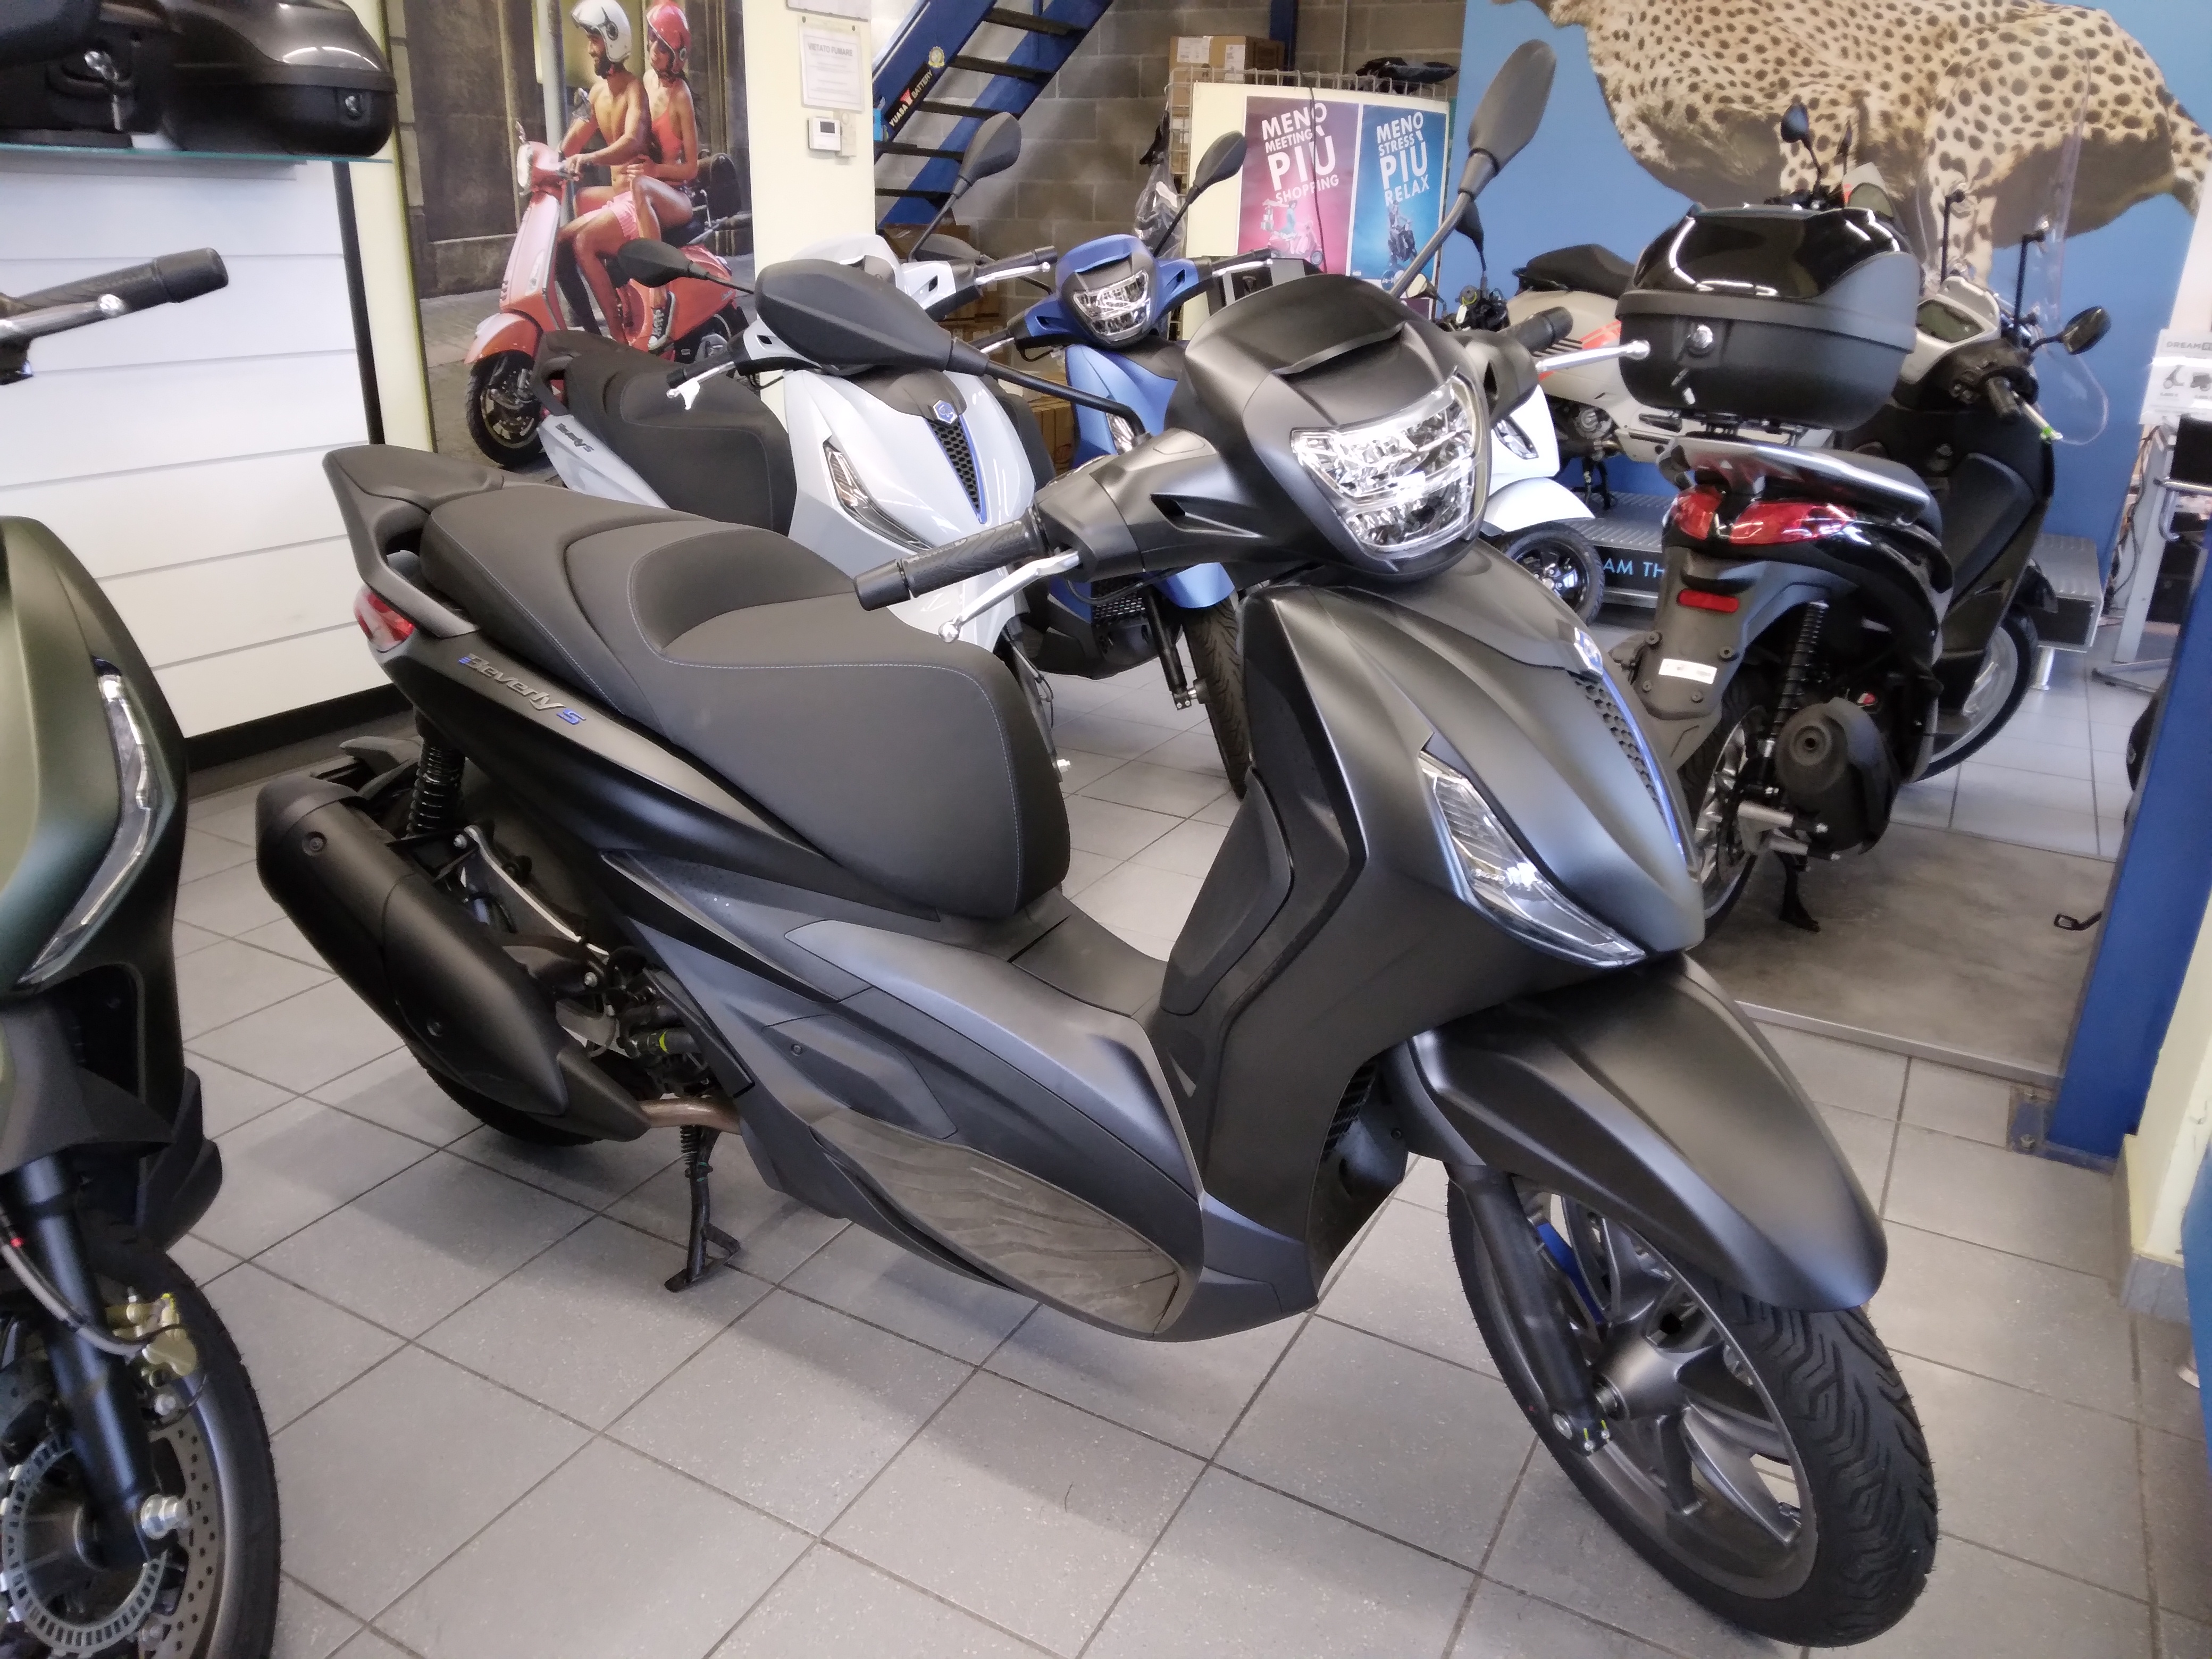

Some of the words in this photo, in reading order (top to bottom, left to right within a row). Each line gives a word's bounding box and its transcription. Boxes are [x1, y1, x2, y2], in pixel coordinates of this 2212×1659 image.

[808, 43, 830, 53] VIETATO
[831, 46, 853, 57] FUMARE
[889, 104, 908, 127] YUASA
[911, 69, 933, 98] BATTERY
[1262, 103, 1327, 140] MENO
[1377, 112, 1423, 144] MENO
[1265, 128, 1313, 154] MEETING
[1378, 133, 1415, 156] STRESS
[1268, 125, 1336, 191] PIÙ
[1380, 130, 1428, 190] PIÙ
[1276, 174, 1339, 204] SHOPPING
[1385, 174, 1430, 207] RELAX
[458, 653, 566, 711] Beverly
[556, 708, 586, 725] S
